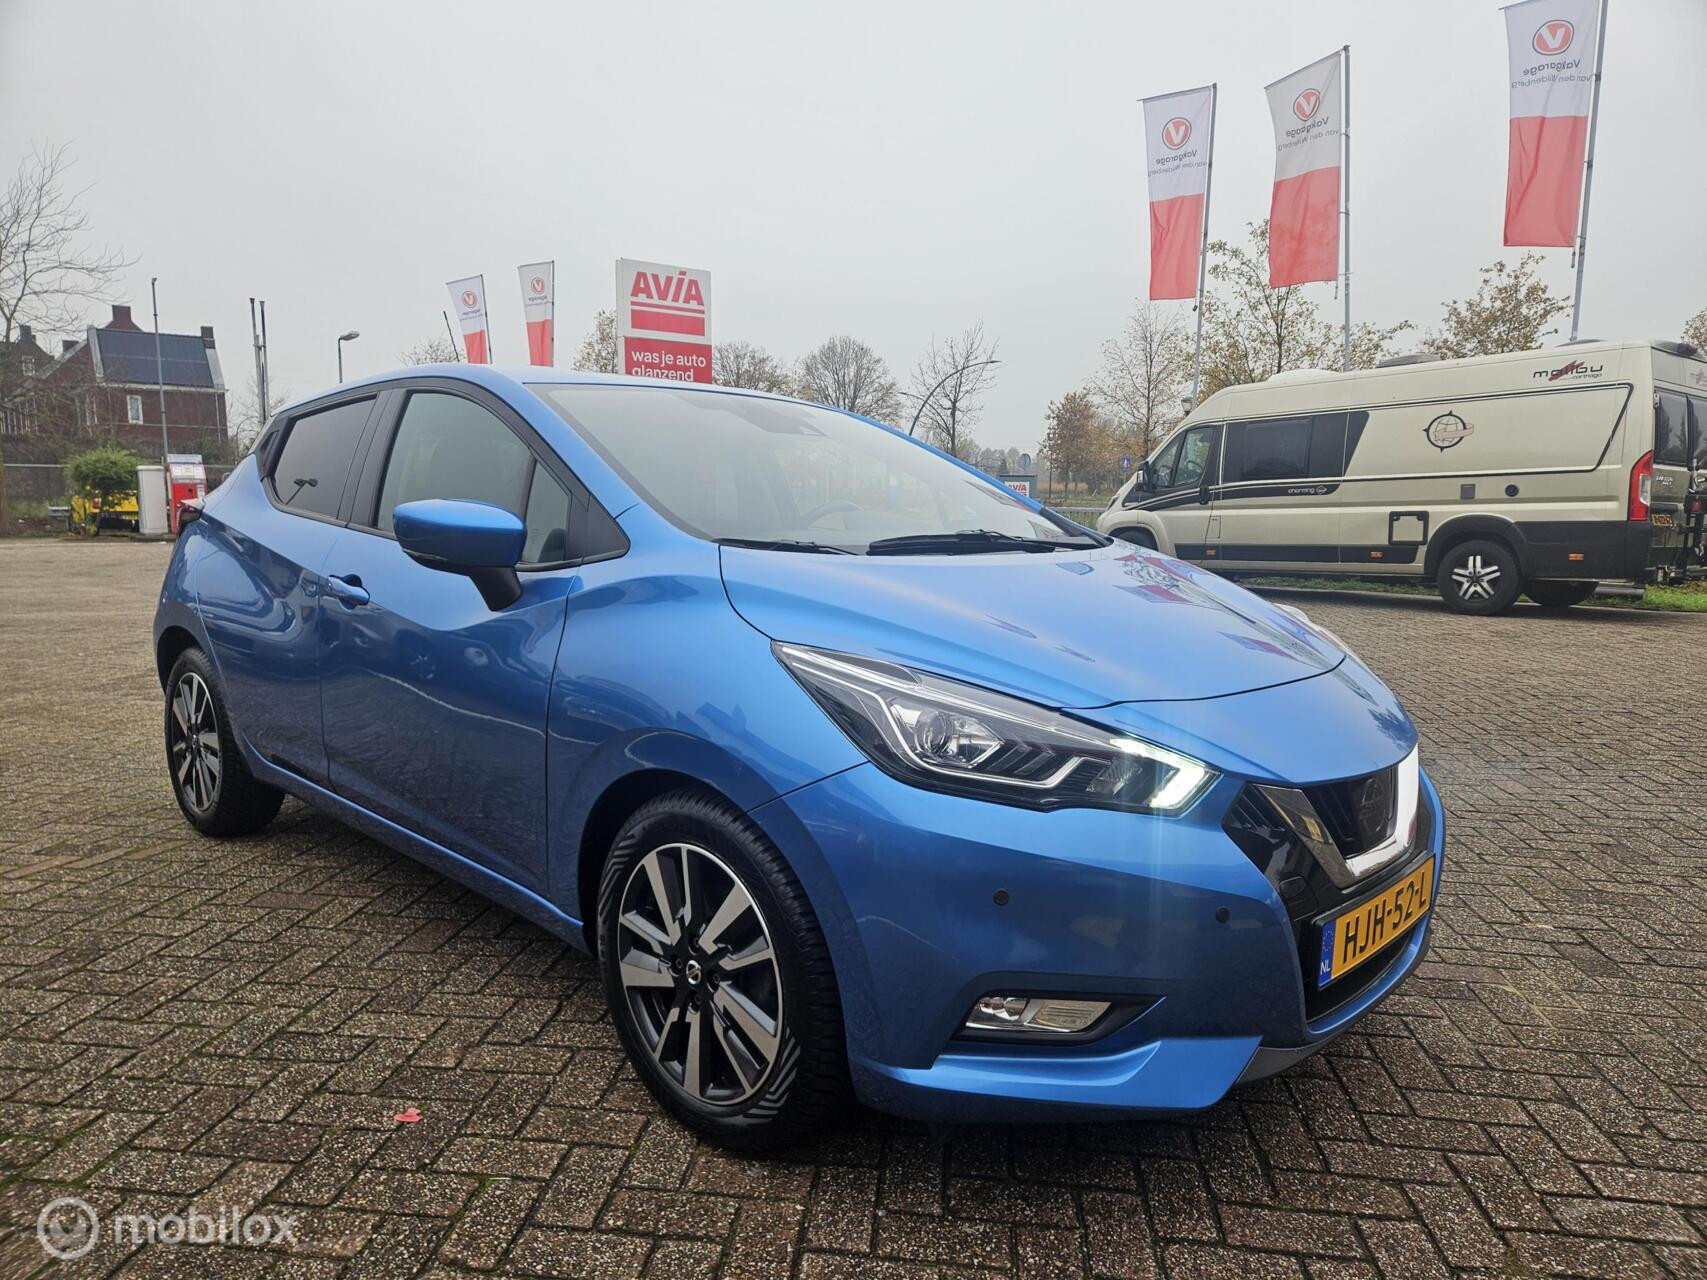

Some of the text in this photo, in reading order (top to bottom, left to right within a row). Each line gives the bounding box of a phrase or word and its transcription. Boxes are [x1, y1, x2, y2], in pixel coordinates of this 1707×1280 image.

[631, 350, 707, 367] was je auto
[1343, 871, 1427, 964] HJH-52-L
[1320, 959, 1331, 975] NL
